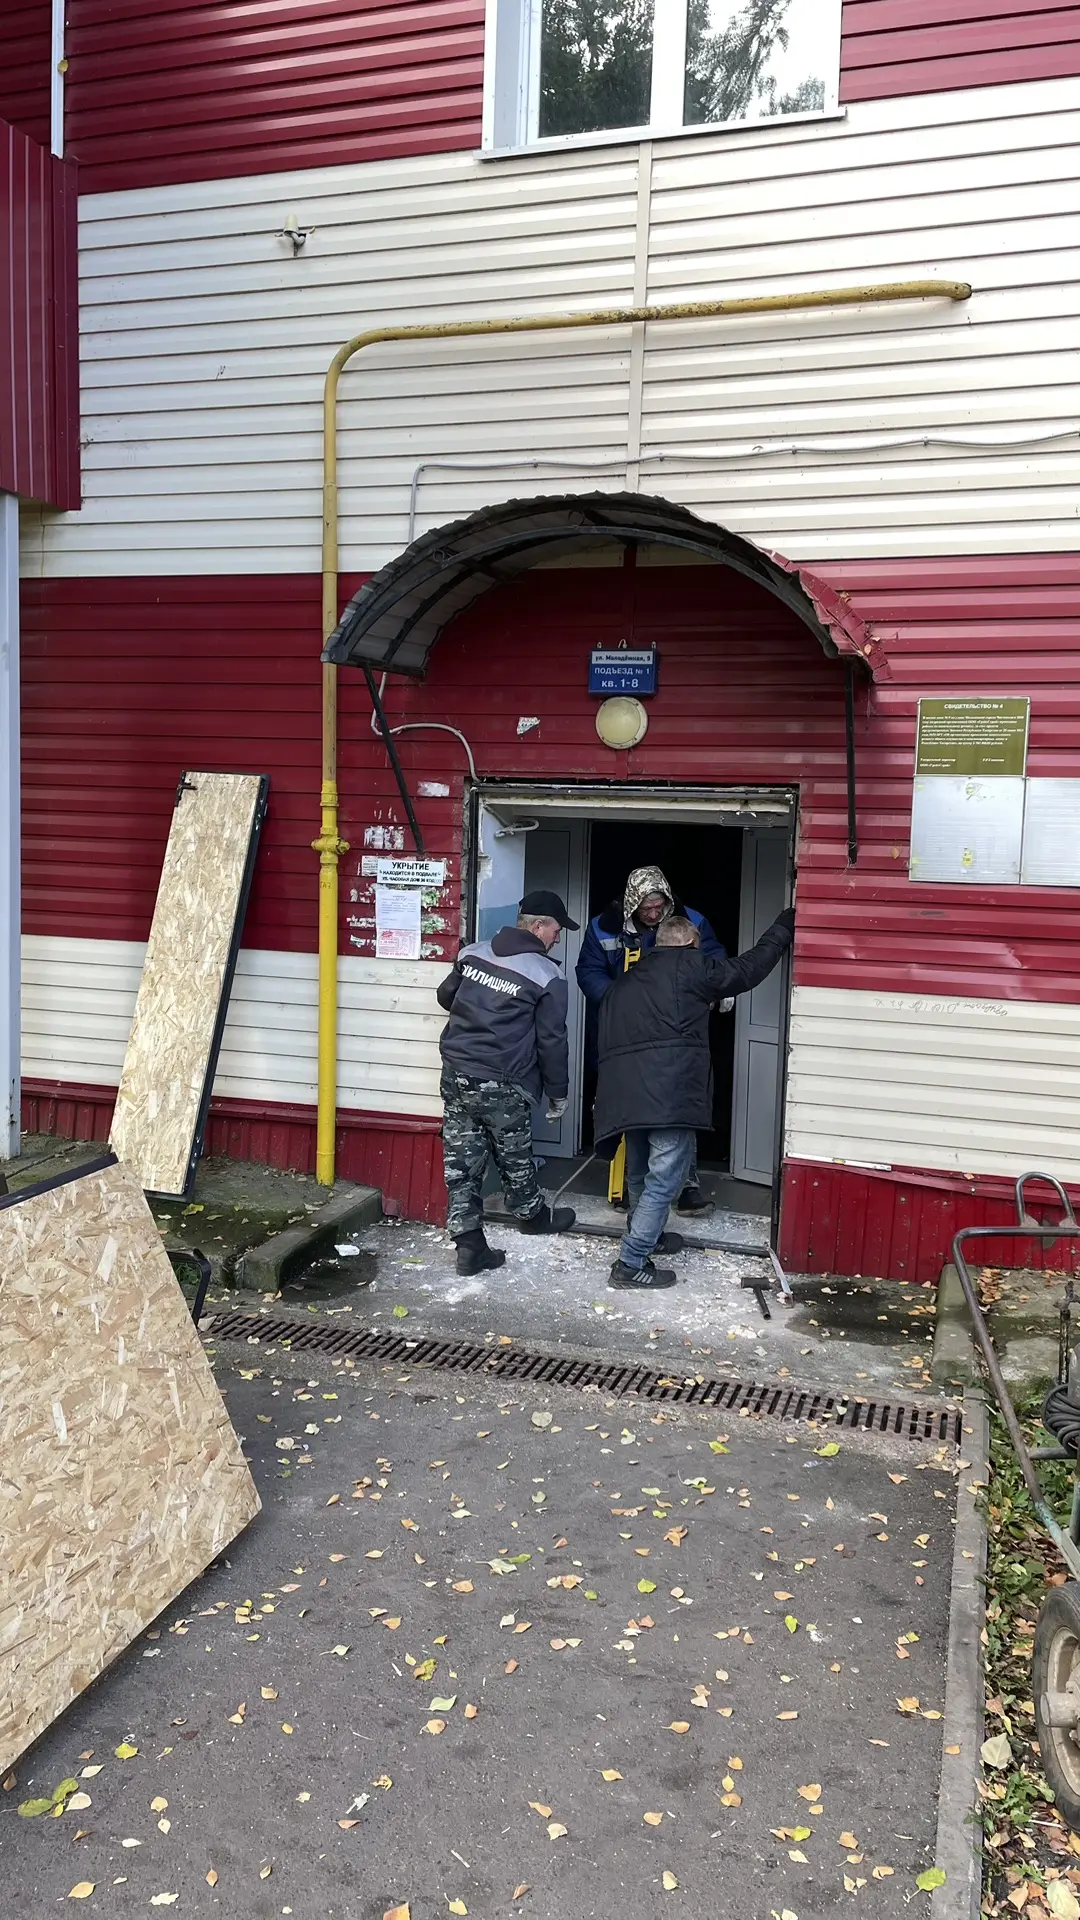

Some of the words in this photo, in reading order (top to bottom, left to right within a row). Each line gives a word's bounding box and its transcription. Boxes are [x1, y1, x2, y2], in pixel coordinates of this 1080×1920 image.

[594, 667, 634, 675] ПОДЪЕЗД
[601, 680, 617, 688] кв.
[620, 678, 639, 688] 1-8
[392, 861, 430, 870] УКРЫТИЕ
